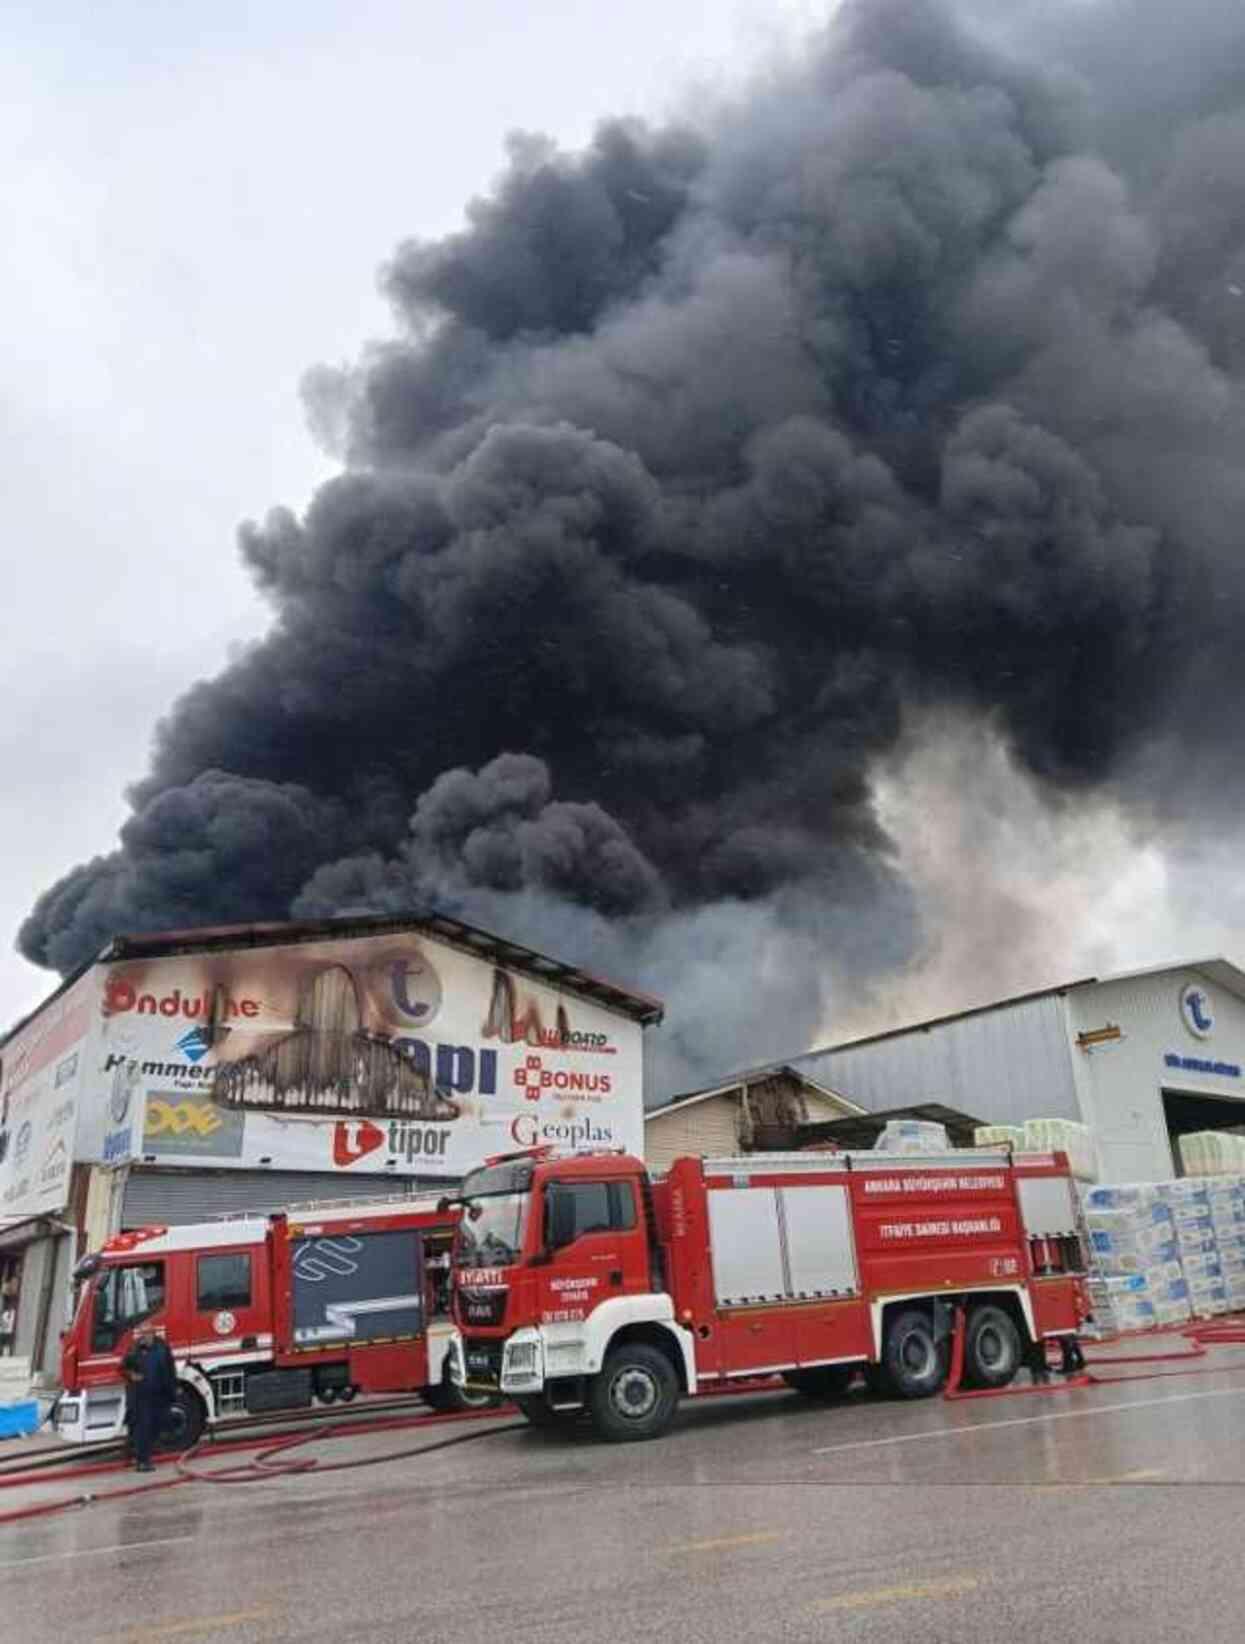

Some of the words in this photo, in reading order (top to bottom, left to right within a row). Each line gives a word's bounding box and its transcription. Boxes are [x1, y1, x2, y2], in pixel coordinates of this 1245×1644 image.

[103, 983, 260, 1020] Ondulne
[541, 1071, 611, 1093] BONUS
[388, 1120, 451, 1163] tipor
[511, 1113, 613, 1149] Geoplas
